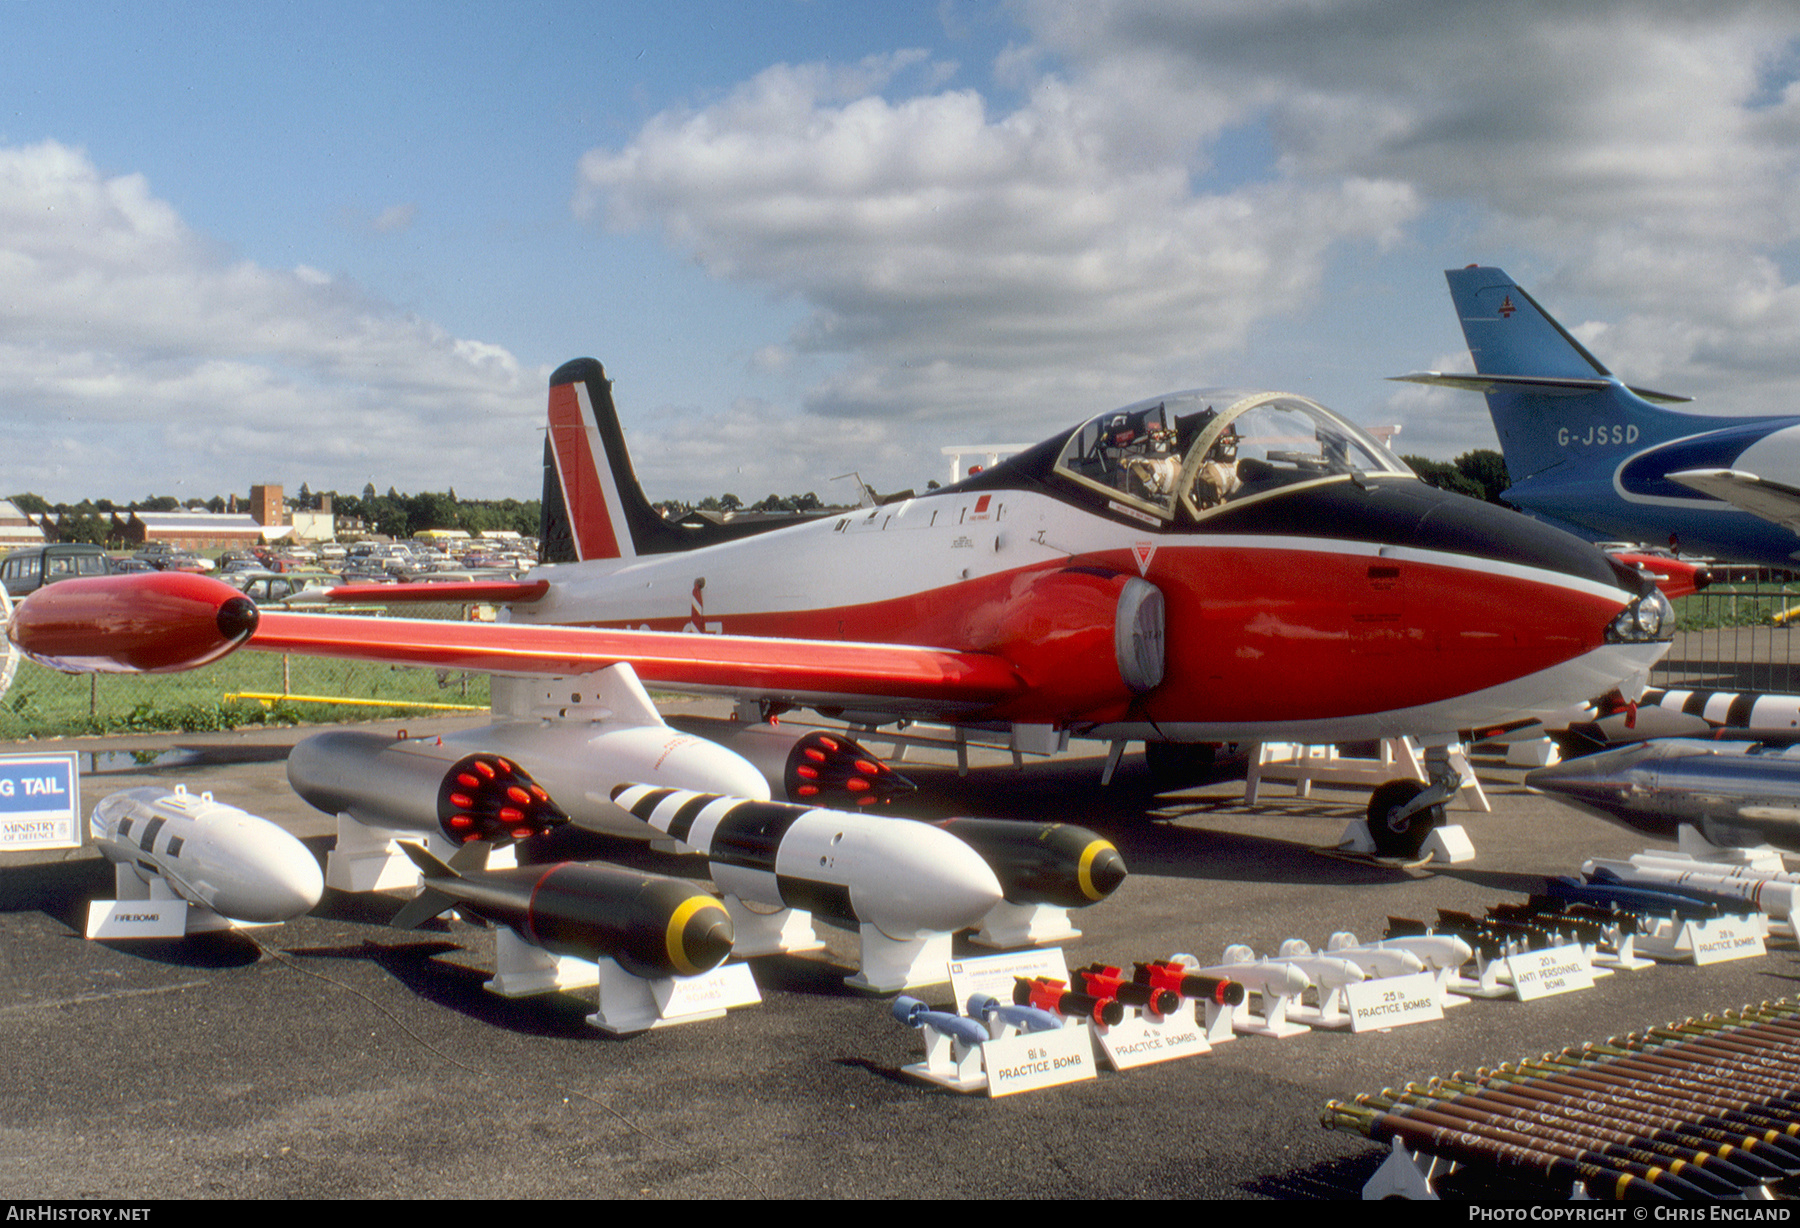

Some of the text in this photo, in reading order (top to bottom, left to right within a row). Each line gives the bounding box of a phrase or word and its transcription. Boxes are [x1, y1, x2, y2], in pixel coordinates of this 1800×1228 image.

[1558, 424, 1639, 446] G-JSSD
[21, 776, 65, 795] TAIL
[4, 822, 56, 833] MINISTRY
[4, 831, 55, 841] OF DEFENCE
[114, 913, 160, 922] FIREBOMB
[1699, 936, 1756, 952] PRACTICE BOMBS
[1539, 956, 1550, 966] 20
[1519, 962, 1583, 983] ANTI PERSONNEL
[1544, 977, 1566, 990] BOMB
[1383, 991, 1405, 1001] 25 lb
[1357, 998, 1432, 1018] PRACTICE BOMBS
[1143, 1029, 1151, 1038] 4
[1115, 1032, 1197, 1055] PRACTICE BOMBS
[1039, 1048, 1047, 1058] lb
[999, 1054, 1082, 1080] PRACTICE BOMB
